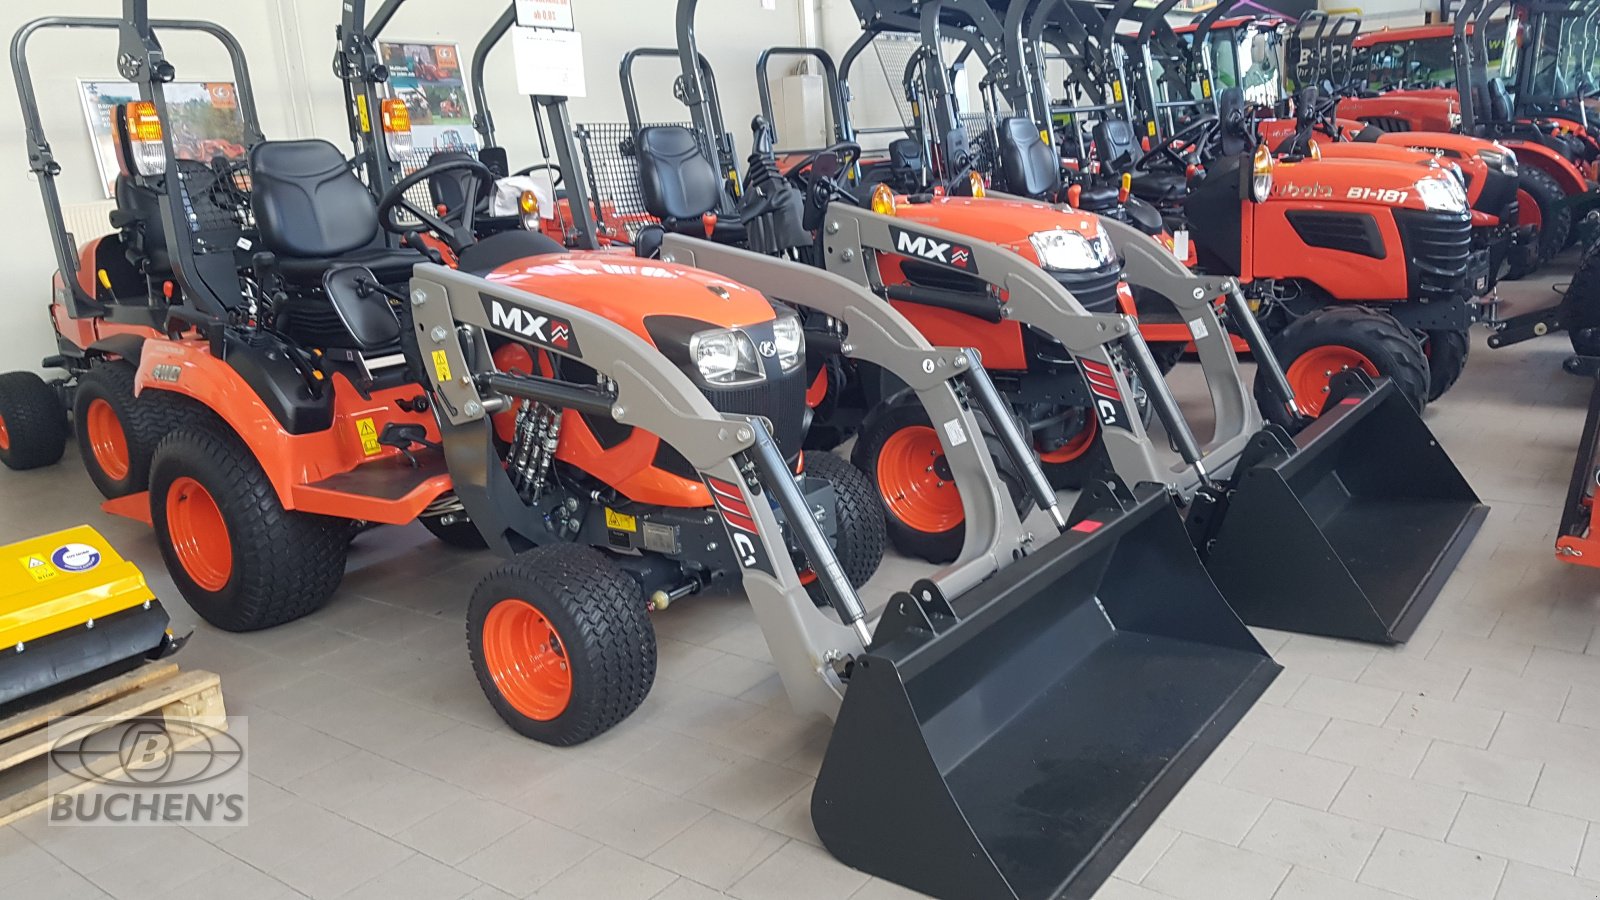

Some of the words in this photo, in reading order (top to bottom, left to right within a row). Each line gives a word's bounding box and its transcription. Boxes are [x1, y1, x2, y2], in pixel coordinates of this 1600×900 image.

[1275, 181, 1333, 197] ubota
[1347, 187, 1408, 203] B1-181
[897, 230, 950, 263] MX
[492, 300, 548, 342] MX
[1098, 399, 1116, 424] C1
[733, 532, 756, 567] C1
